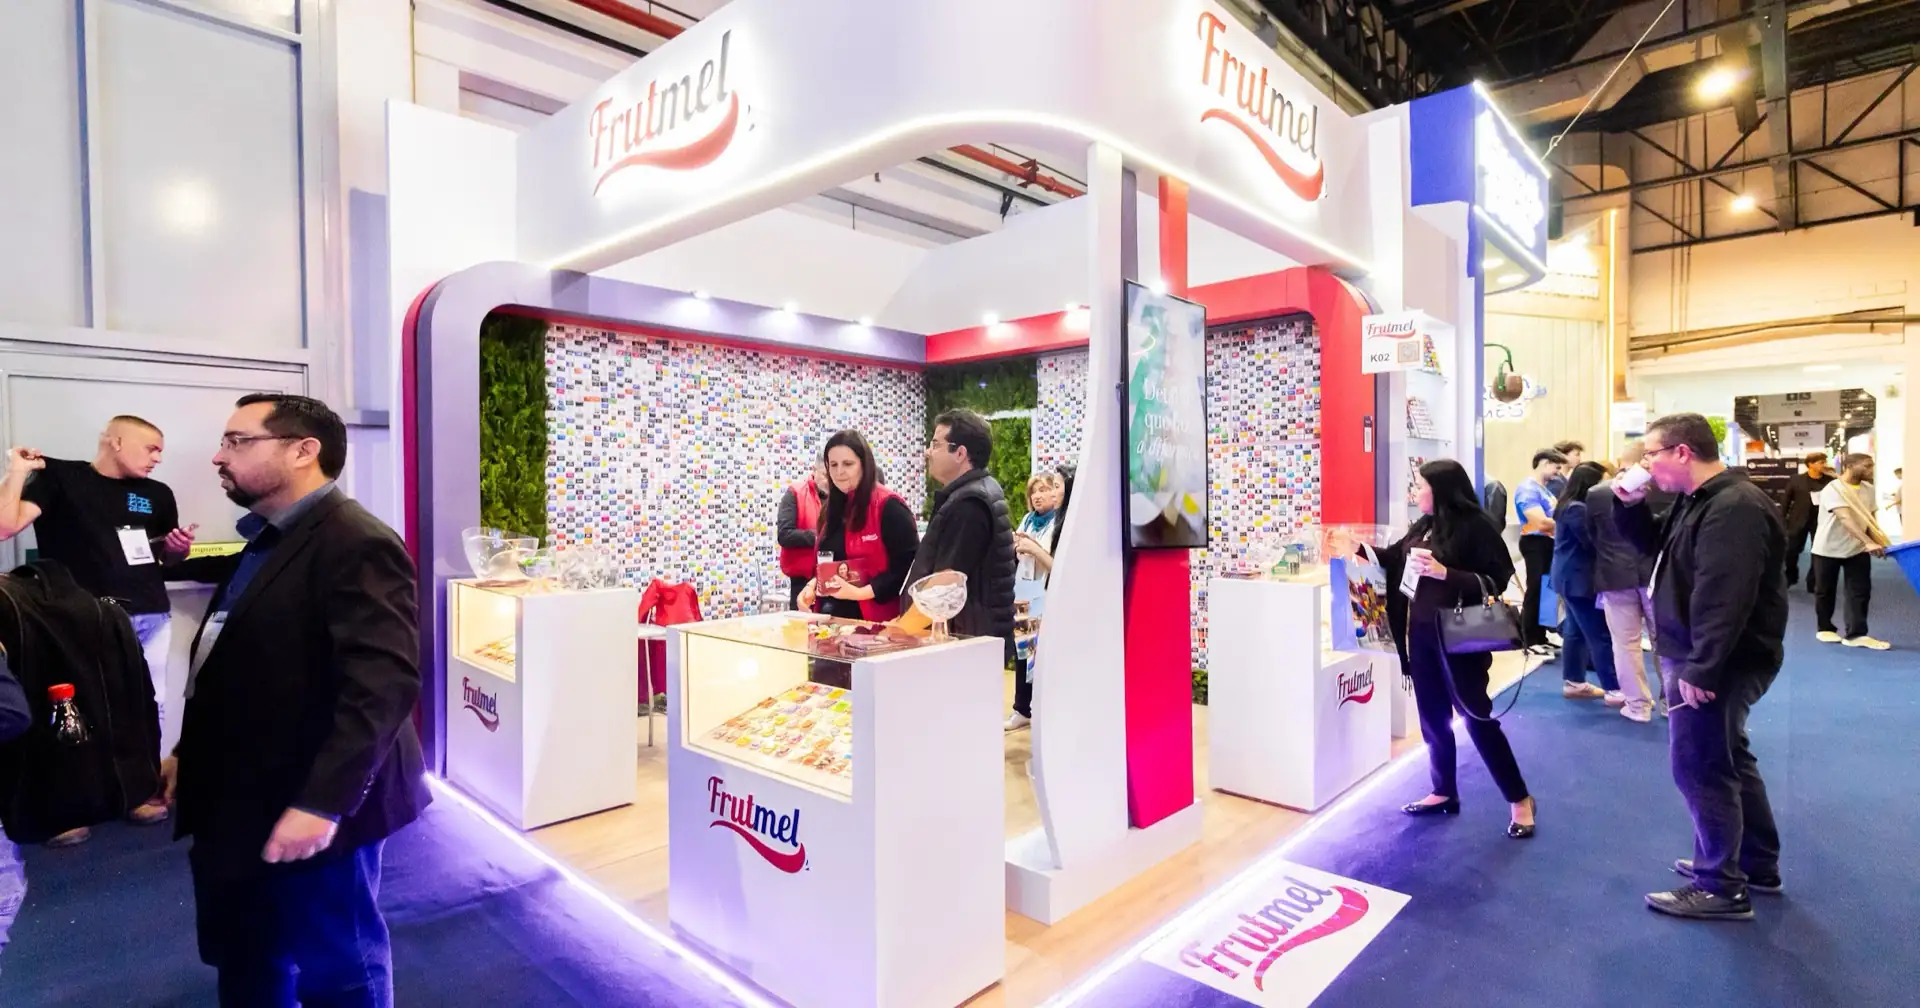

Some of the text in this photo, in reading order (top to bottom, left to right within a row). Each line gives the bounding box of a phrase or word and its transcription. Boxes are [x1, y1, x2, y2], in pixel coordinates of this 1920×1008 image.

[589, 29, 732, 169] Frutmel
[1198, 11, 1318, 160] Frutmel
[1370, 353, 1390, 362] K02
[462, 676, 497, 716] Frutmel
[1336, 662, 1373, 700] Frutmel
[708, 776, 800, 847] Frutmel
[1180, 875, 1334, 979] Frutmel
